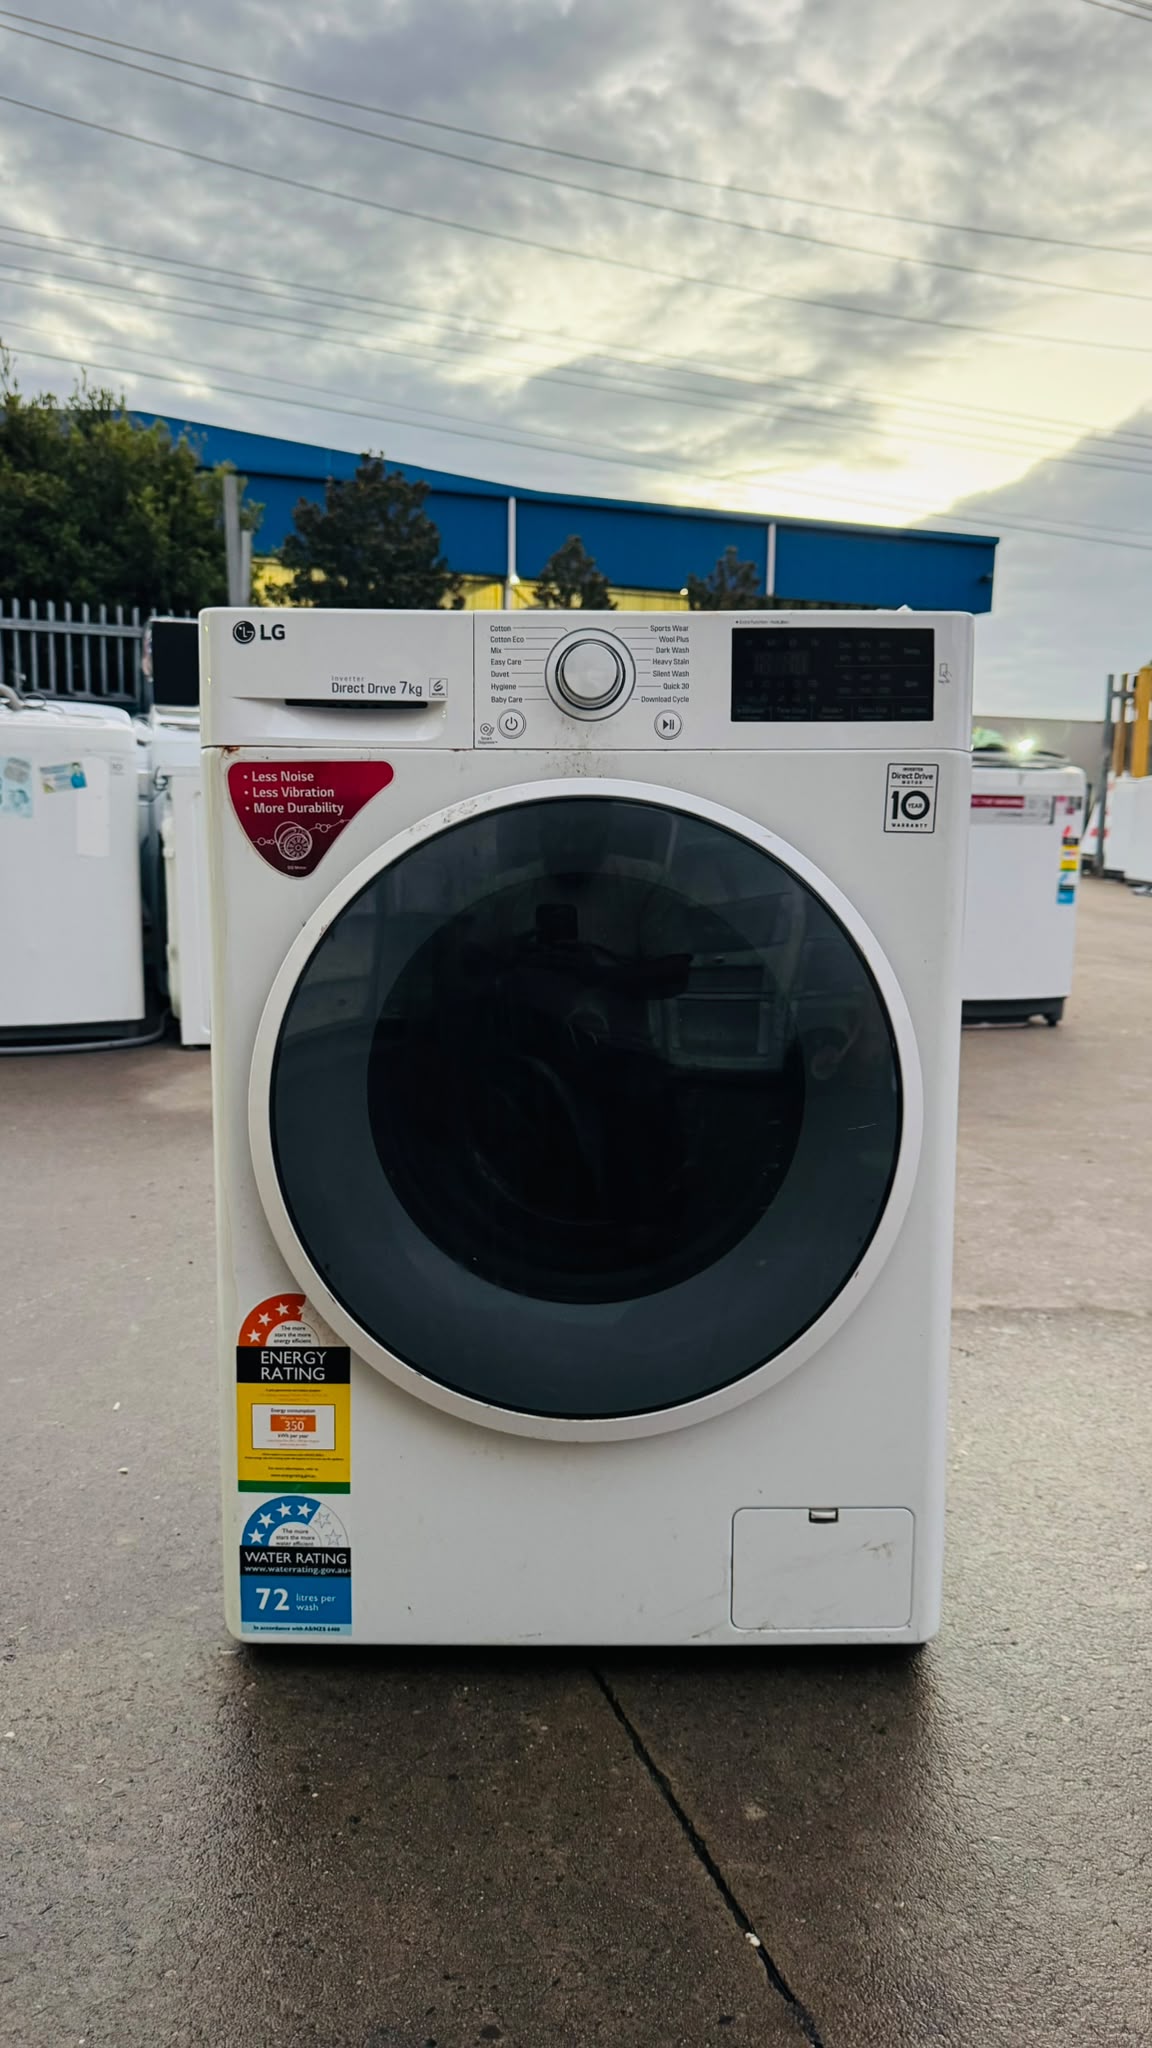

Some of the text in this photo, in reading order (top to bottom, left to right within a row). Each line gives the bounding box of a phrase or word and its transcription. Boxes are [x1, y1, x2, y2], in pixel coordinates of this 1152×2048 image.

[260, 624, 285, 640] LG
[650, 625, 671, 634] Sports
[491, 658, 522, 667] Easy Care
[653, 658, 690, 667] Heavy Stain
[491, 670, 509, 678] Duvet
[653, 670, 690, 678] Silent Wash
[331, 681, 423, 697] Direct Drive 7kg
[491, 683, 517, 692] Hygiene
[664, 682, 690, 690] Quick 30
[492, 696, 523, 705] Baby Care
[641, 696, 690, 705] Download Cycle
[252, 771, 314, 782] Less Noise
[914, 772, 934, 780] Drive
[253, 786, 335, 798] Less Vibration
[254, 802, 344, 816] More Durability
[891, 790, 930, 820] 10
[261, 1351, 327, 1365] ENERGY
[261, 1367, 325, 1381] RATING
[285, 1421, 304, 1431] 350
[245, 1552, 347, 1564] WATER RATING
[244, 1566, 348, 1575] www.waterrating.gov.au
[256, 1588, 290, 1611] 72
[296, 1593, 336, 1604] litres per
[296, 1603, 319, 1611] wash
